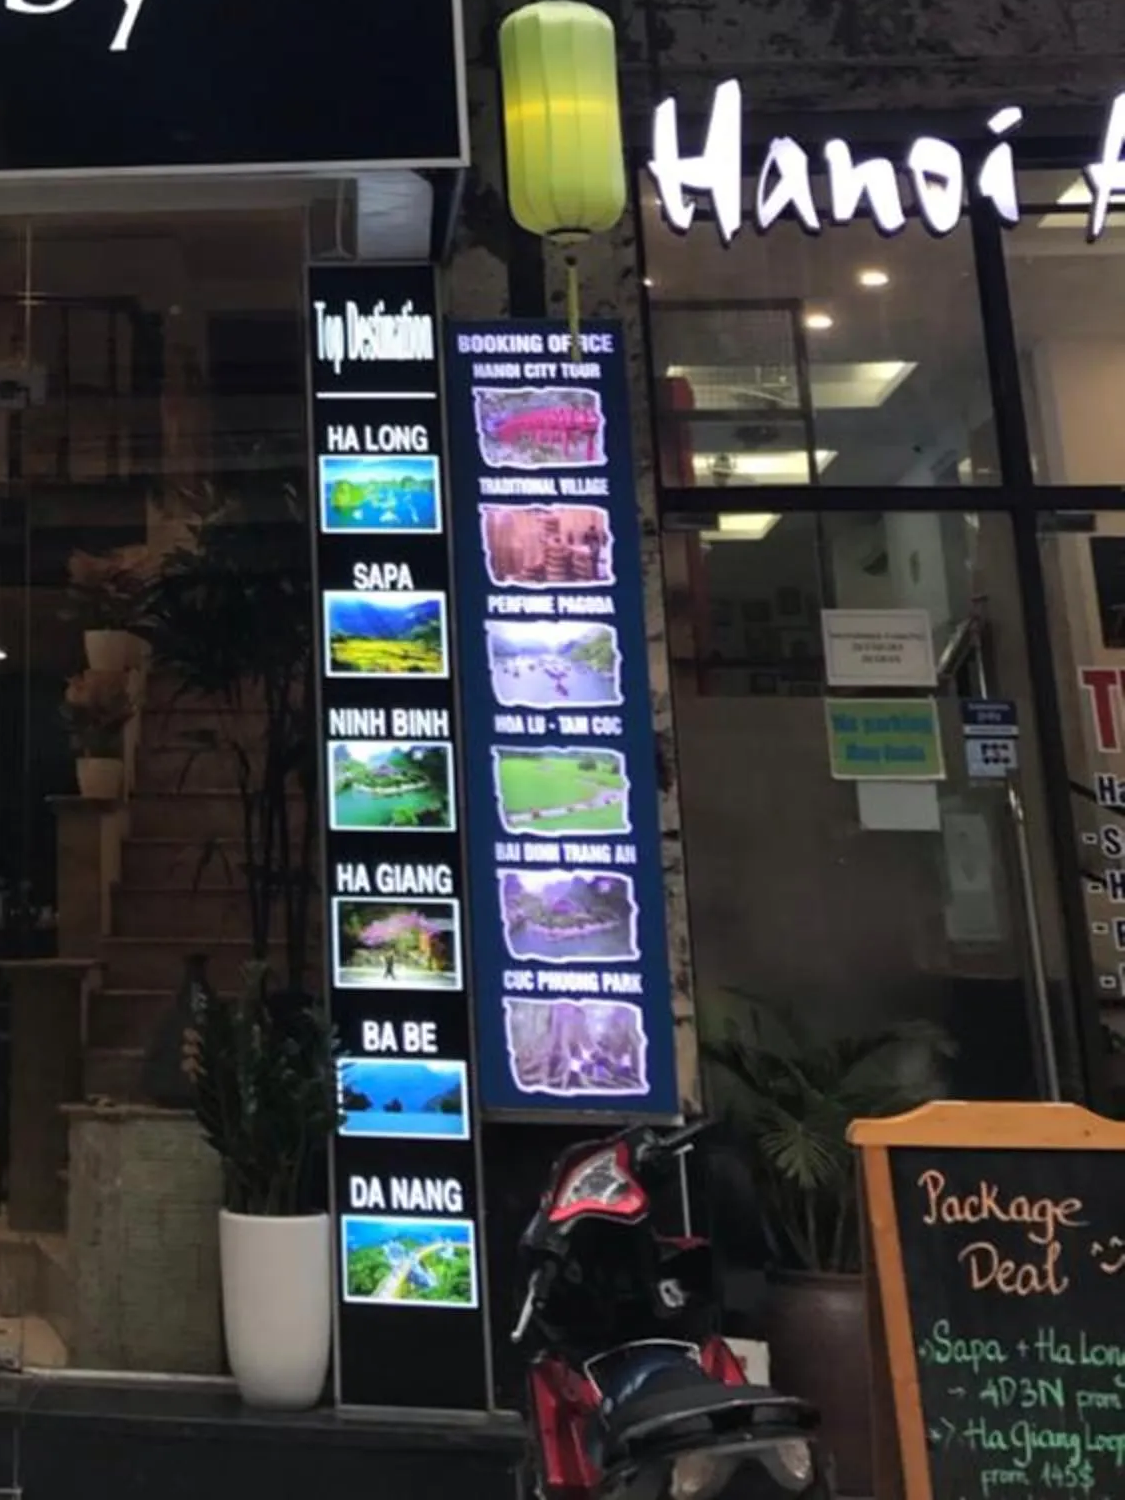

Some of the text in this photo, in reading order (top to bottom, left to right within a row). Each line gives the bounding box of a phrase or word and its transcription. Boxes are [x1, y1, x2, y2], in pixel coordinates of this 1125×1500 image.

[646, 78, 1023, 241] Hanoi
[313, 299, 434, 374] Top Destination
[458, 333, 615, 353] BOOKING OFICE
[473, 362, 602, 379] HANOI CITY TOUR
[327, 424, 429, 452] HA LONG
[353, 561, 414, 590] SAPA
[329, 708, 450, 738] NINH BINH
[336, 863, 453, 895] HA GIANG
[601, 972, 643, 994] PARK
[362, 1020, 439, 1053] BA BE
[350, 1175, 463, 1213] DA NANG
[918, 1169, 1089, 1244] Package
[957, 1240, 1070, 1297] Deal
[932, 1319, 1009, 1375] Sapa
[1035, 1326, 1075, 1365] Ha
[963, 1416, 1008, 1450] Ha
